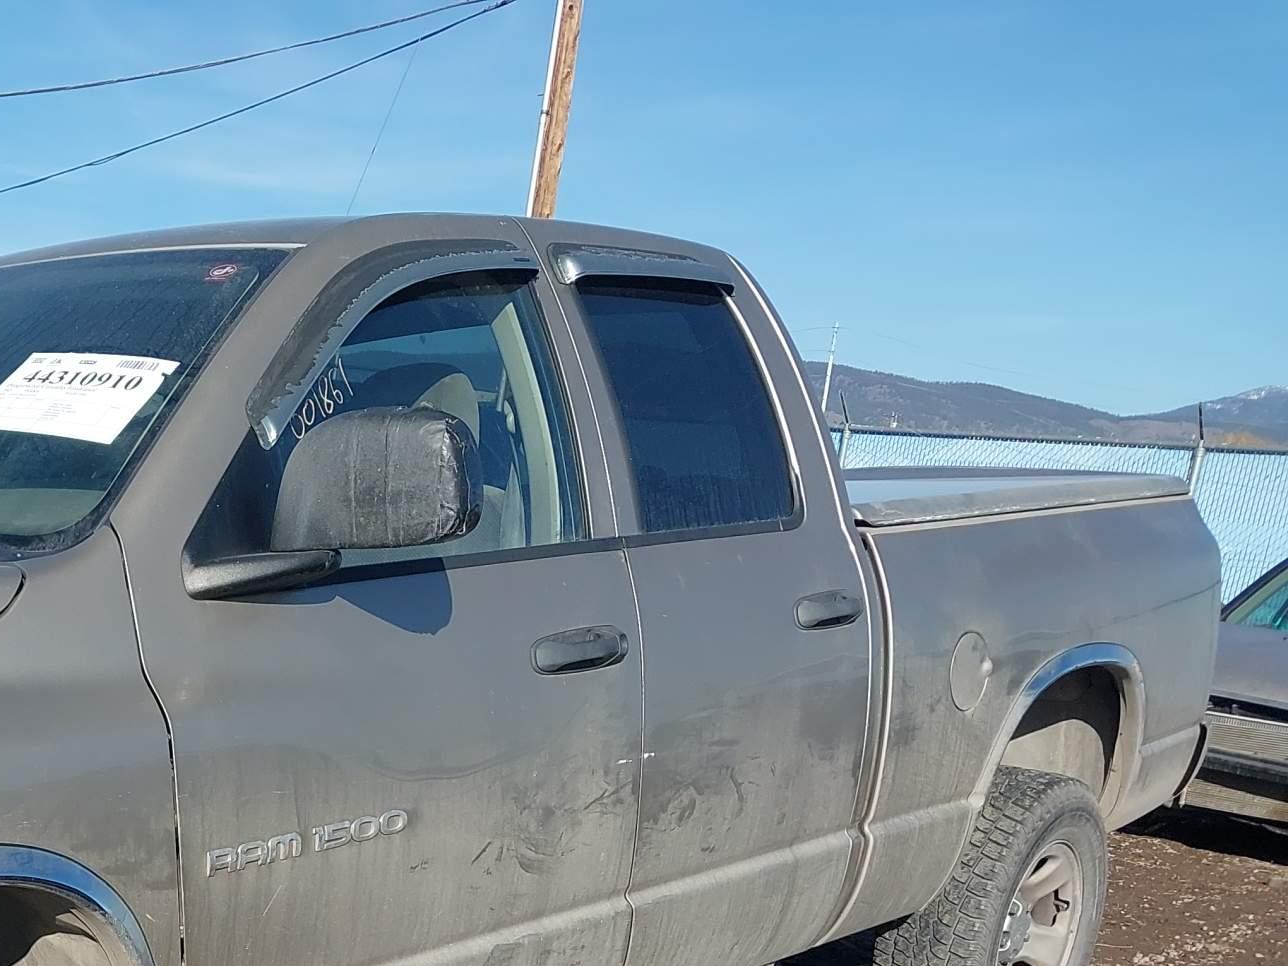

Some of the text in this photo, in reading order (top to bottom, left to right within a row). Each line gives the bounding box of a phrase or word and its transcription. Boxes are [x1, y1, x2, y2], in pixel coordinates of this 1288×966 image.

[22, 369, 143, 392] 44310910
[206, 808, 409, 878] RAM 1500
